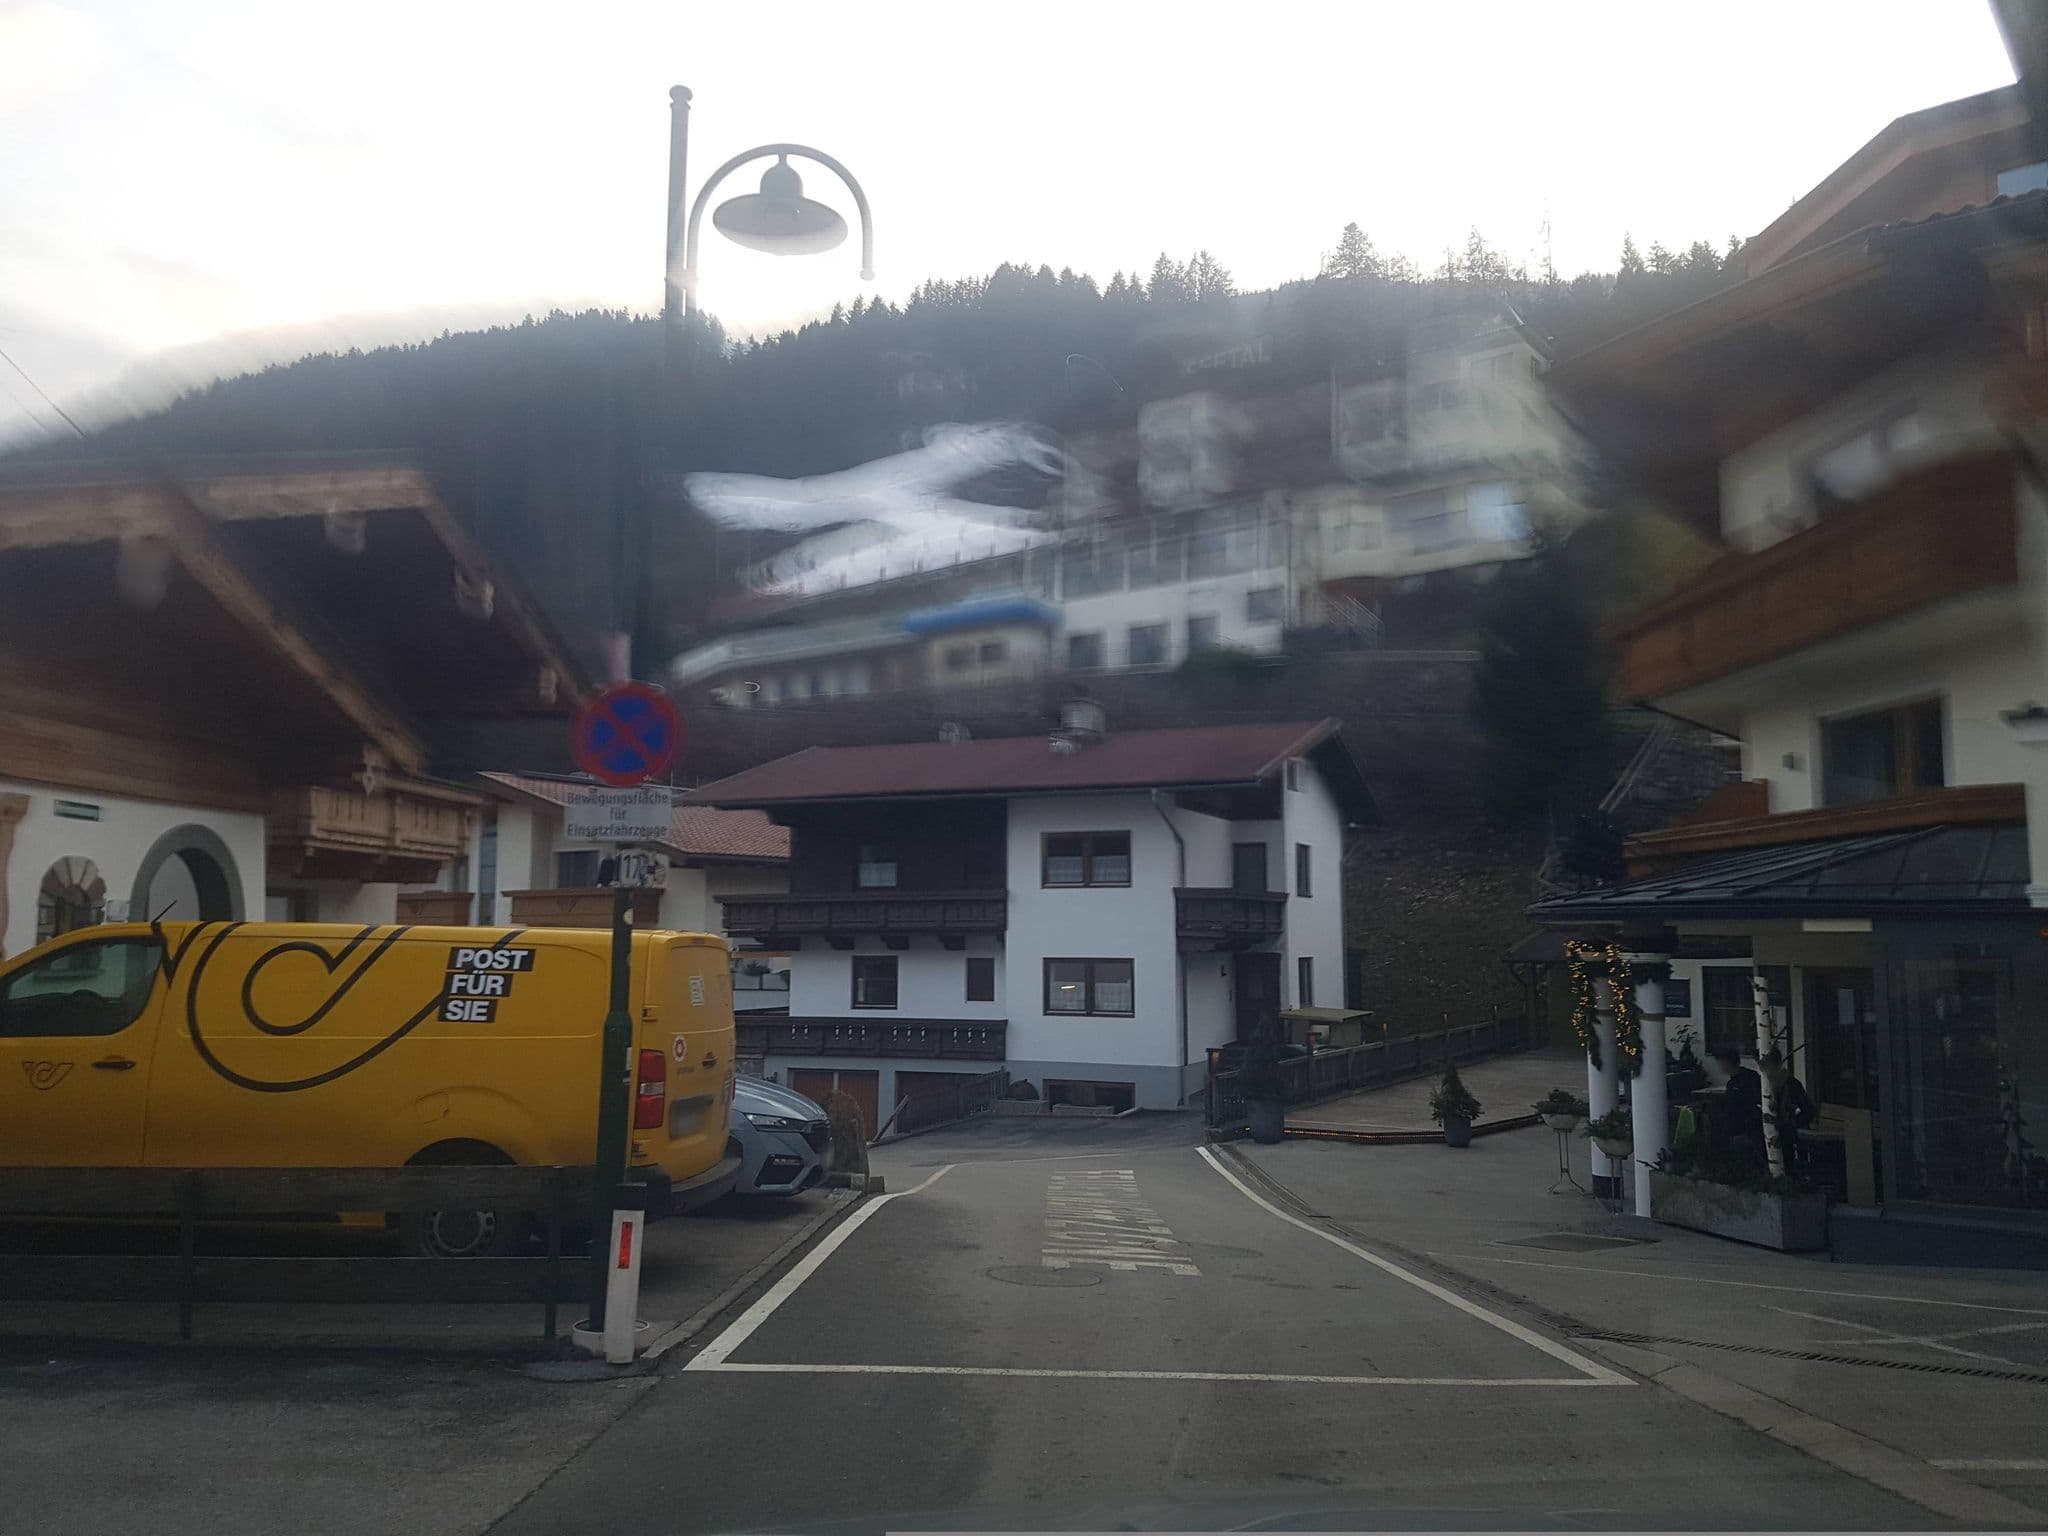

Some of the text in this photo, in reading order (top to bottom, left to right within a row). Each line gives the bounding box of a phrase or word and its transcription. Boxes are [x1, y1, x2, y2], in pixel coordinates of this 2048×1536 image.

[609, 807, 628, 821] für
[567, 823, 668, 839] Einsatzfahrzeuge
[455, 948, 529, 970] POST
[449, 970, 505, 995] FÜR
[444, 1000, 490, 1021] SIE
